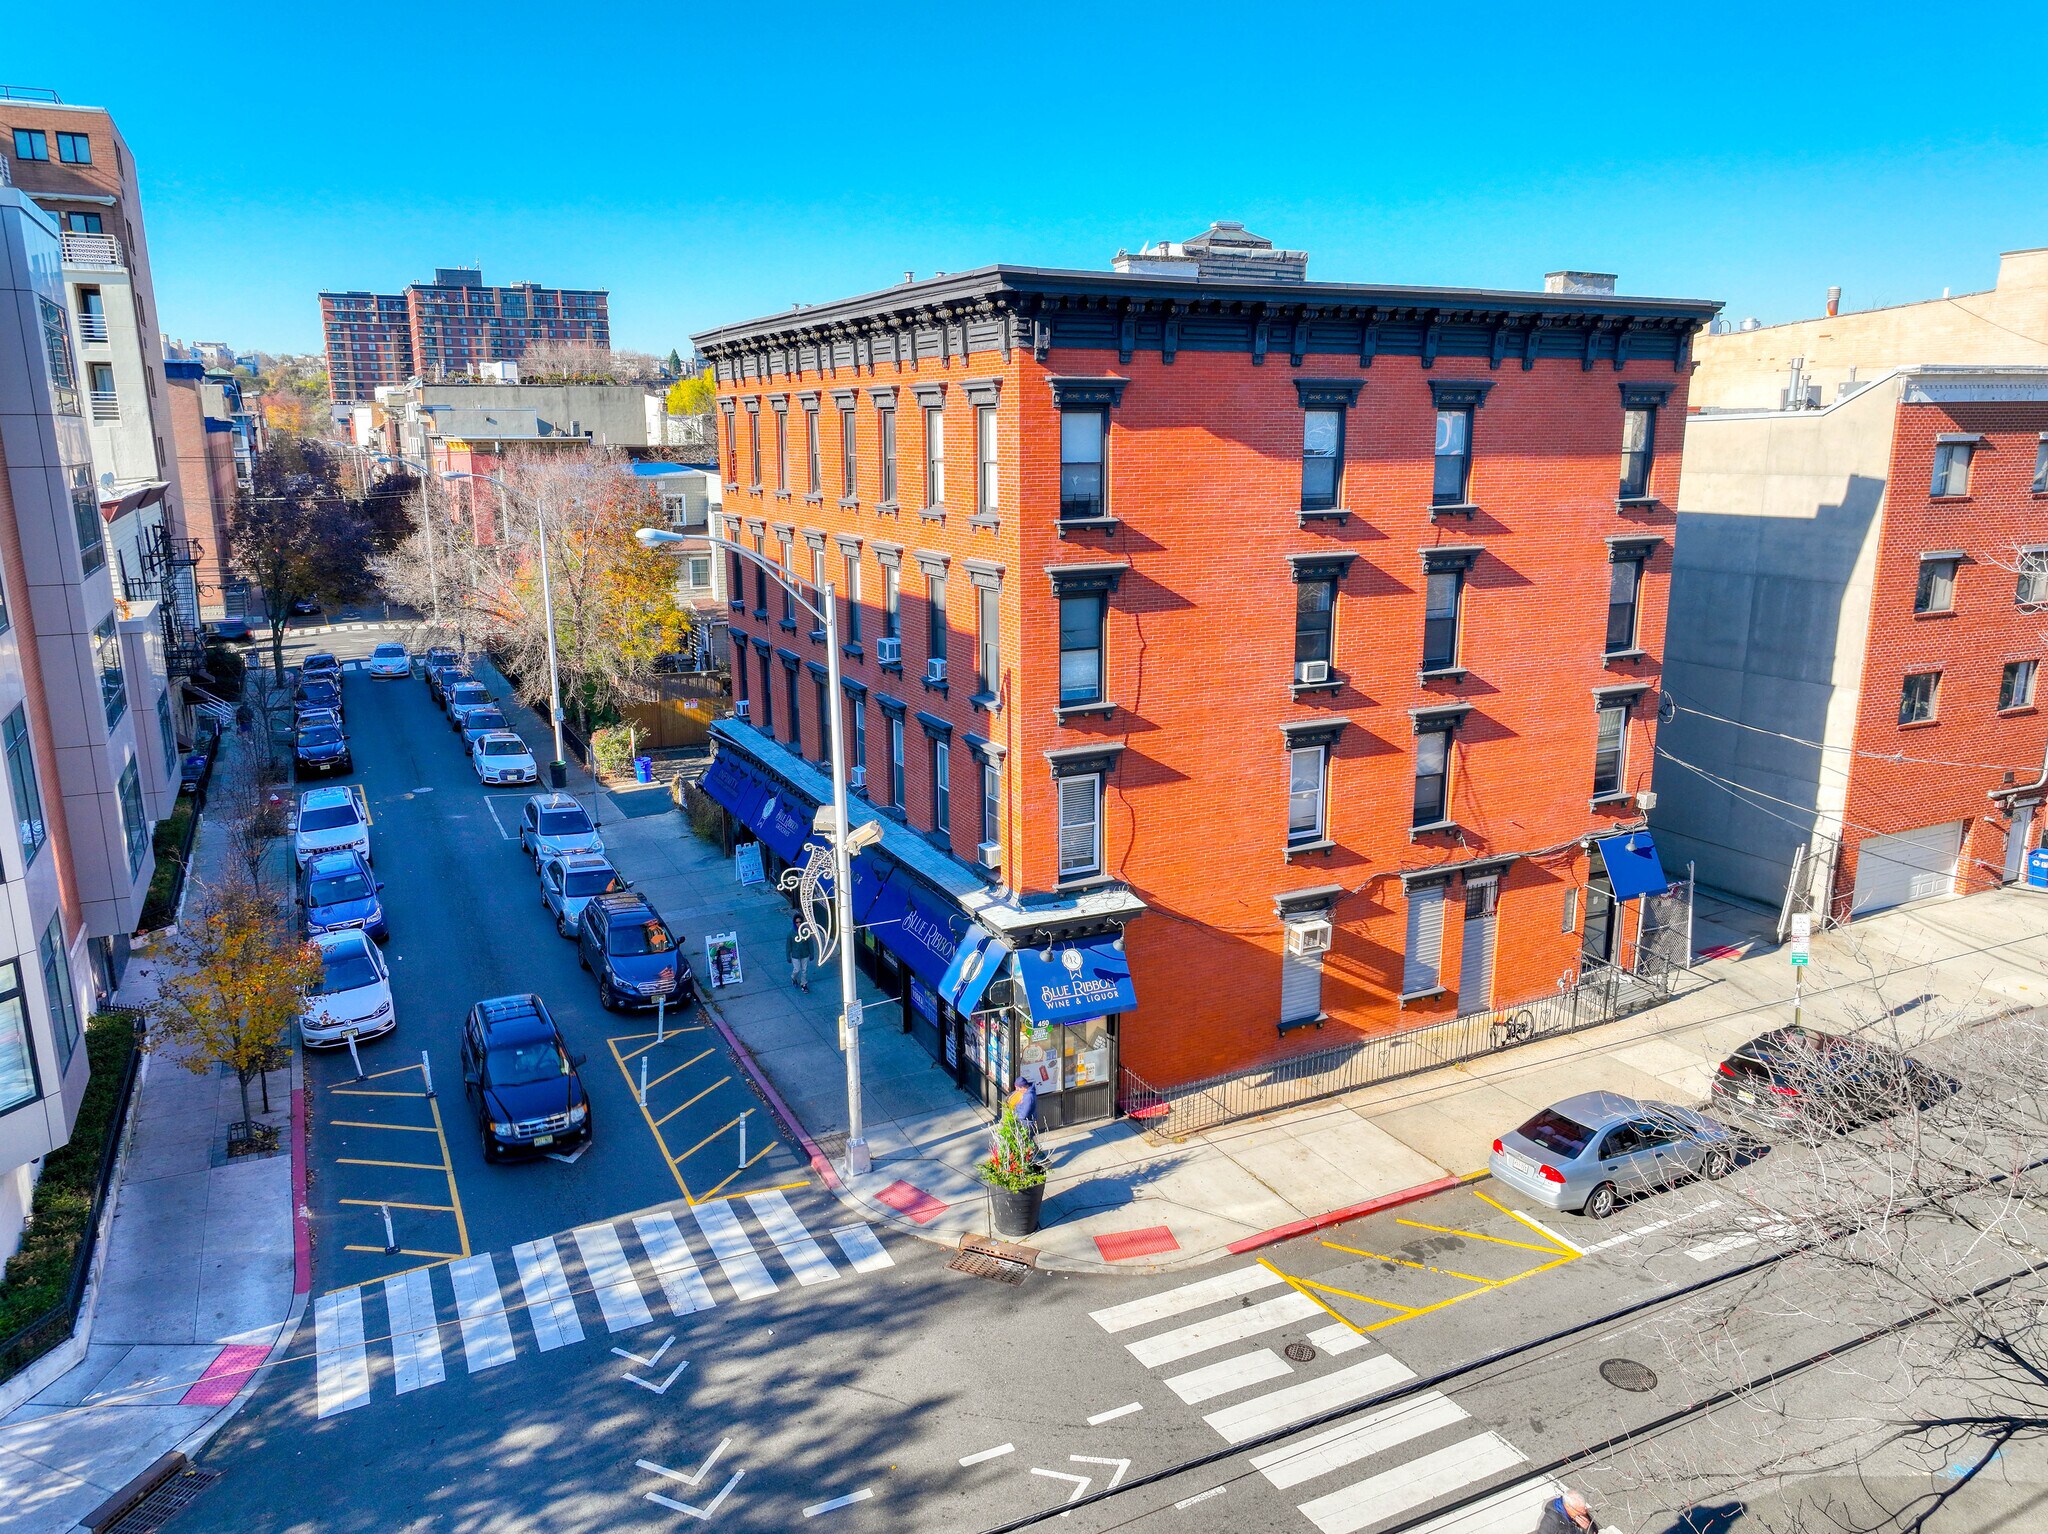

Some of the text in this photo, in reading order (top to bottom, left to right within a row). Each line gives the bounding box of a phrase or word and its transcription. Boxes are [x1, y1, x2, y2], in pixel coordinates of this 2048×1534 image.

[902, 910, 959, 958] BLUE RIBBON
[1041, 977, 1116, 1004] BLUE RIBBON
[1046, 990, 1119, 1010] WINE & LIQUOR
